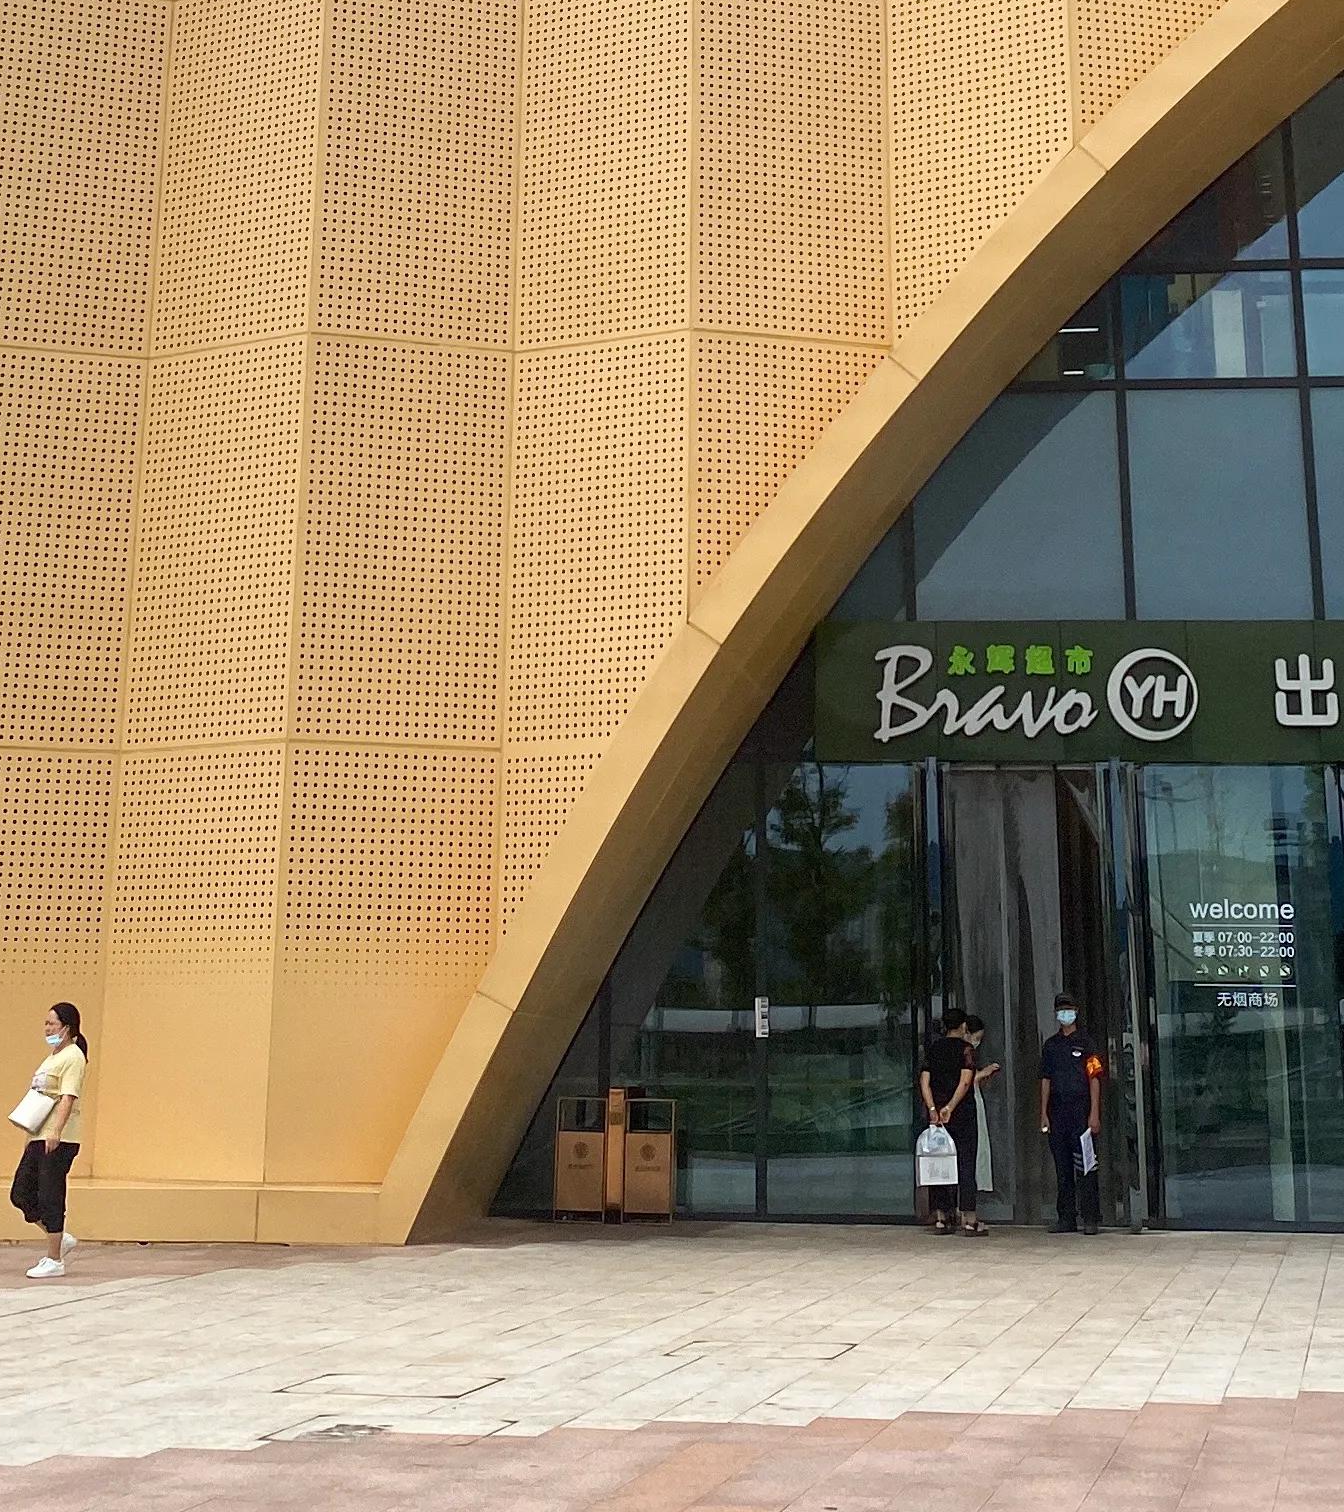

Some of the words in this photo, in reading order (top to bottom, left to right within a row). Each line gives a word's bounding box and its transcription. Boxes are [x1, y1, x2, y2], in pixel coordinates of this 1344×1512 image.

[874, 645, 1099, 743] Bravo
[1124, 674, 1188, 719] YH
[1188, 898, 1295, 920] welcome
[1216, 991, 1279, 1007] 无烟商场
